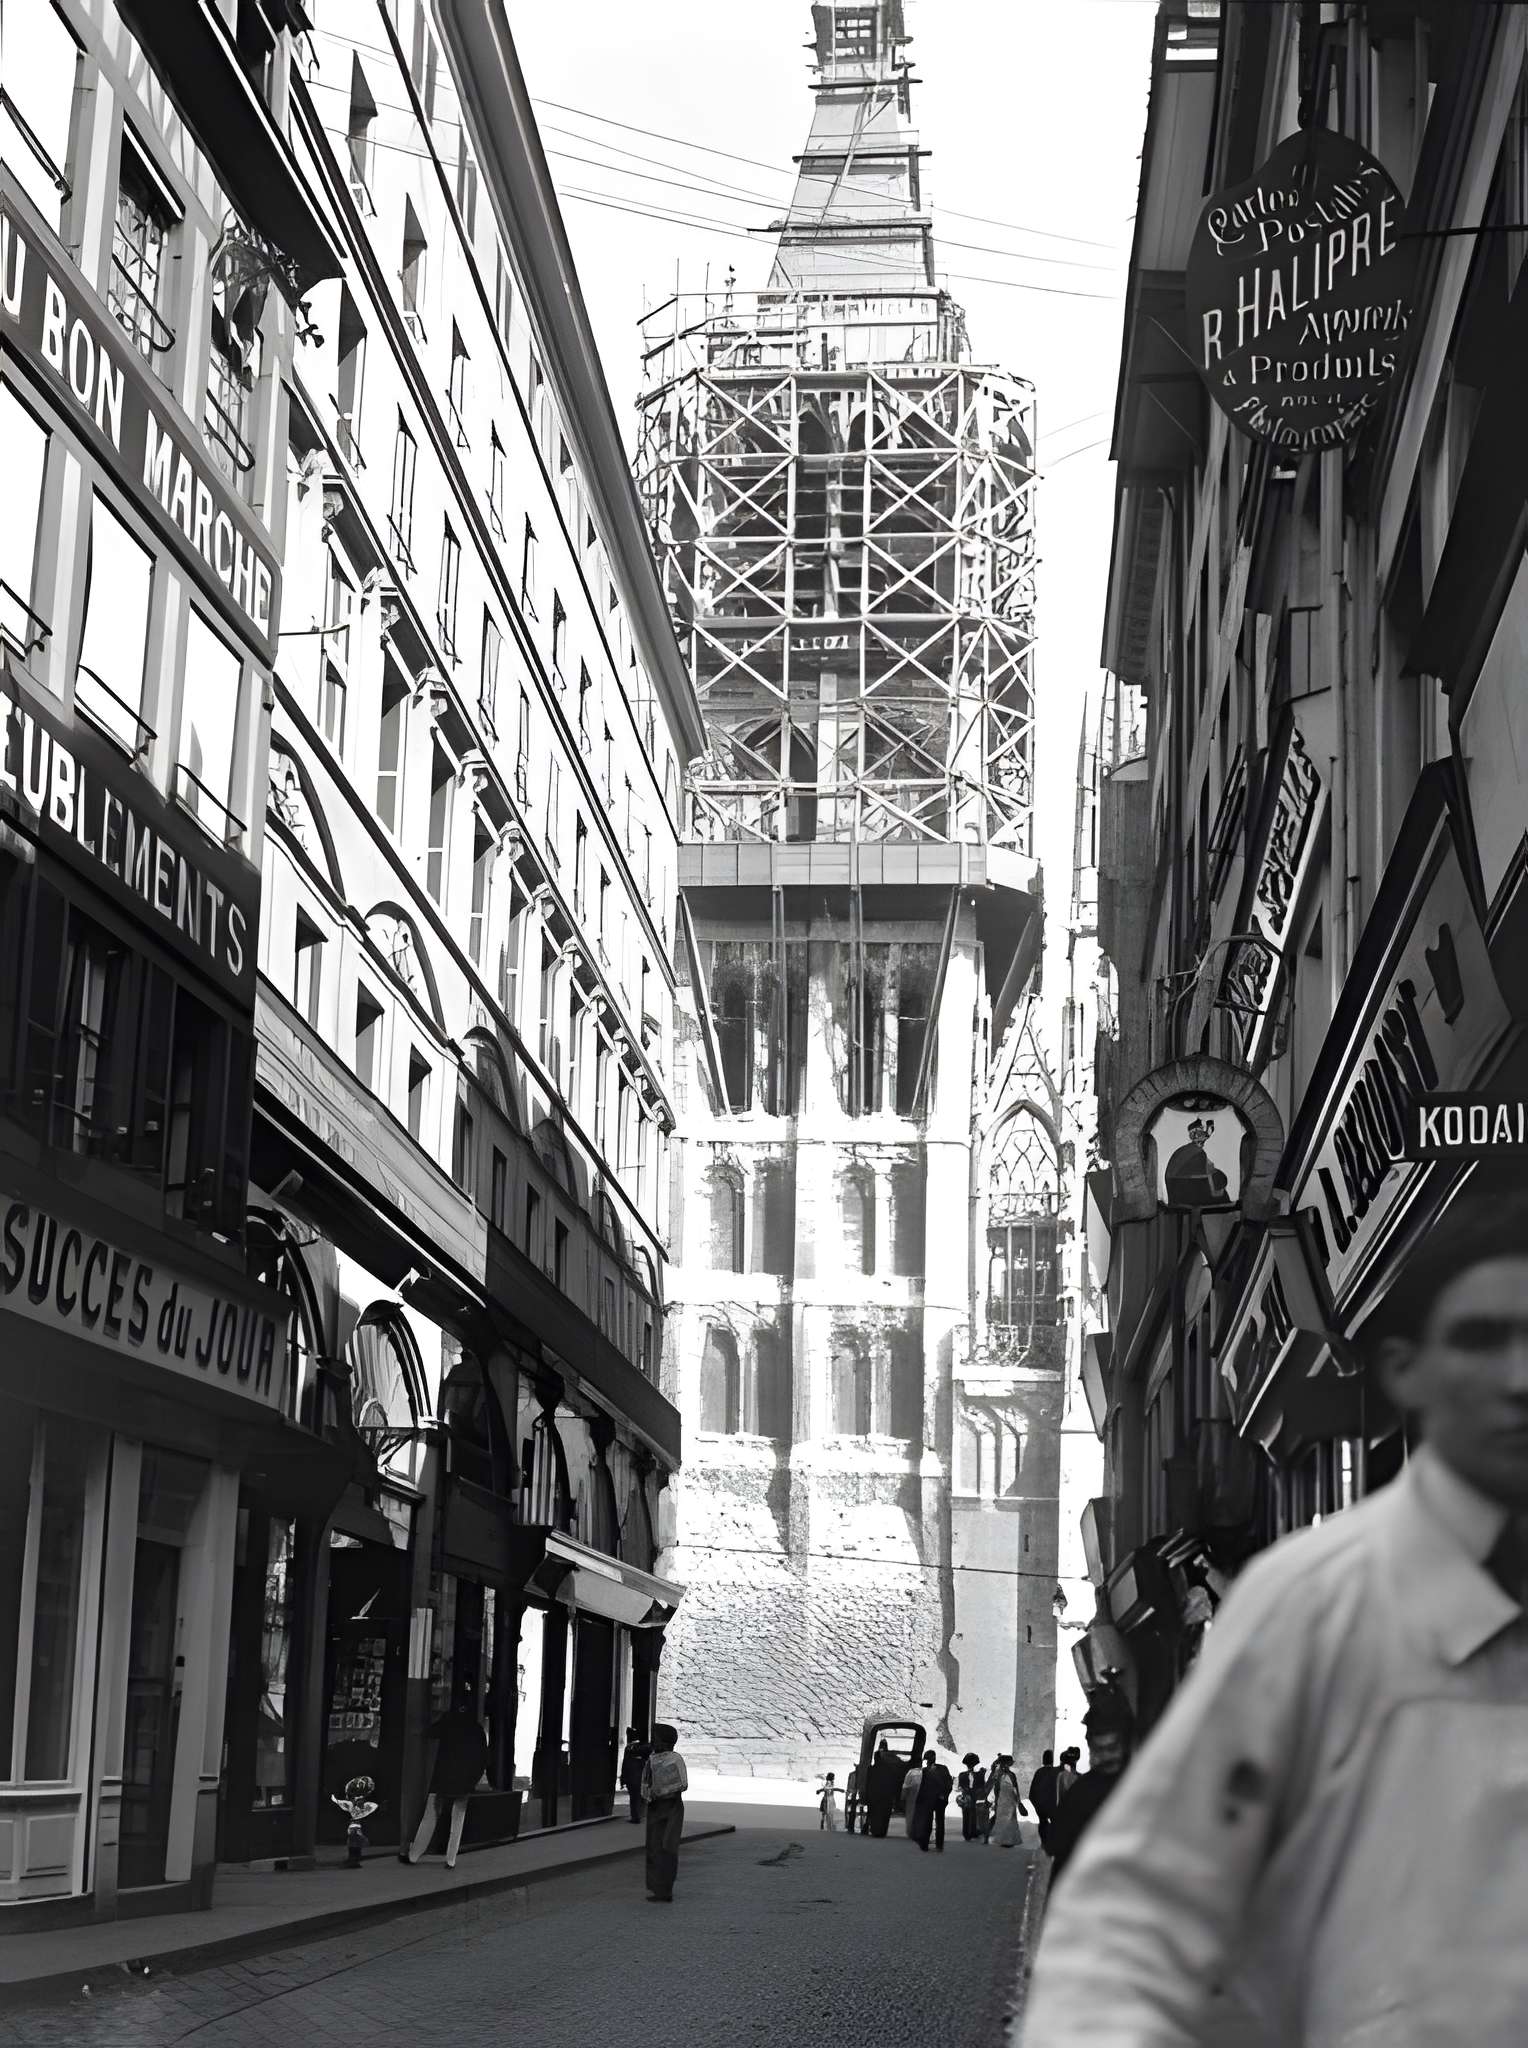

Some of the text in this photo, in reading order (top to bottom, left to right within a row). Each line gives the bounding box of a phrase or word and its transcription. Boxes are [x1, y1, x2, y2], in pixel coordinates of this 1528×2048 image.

[1203, 309, 1223, 370] R
[41, 273, 125, 454] BON
[143, 409, 271, 641] MARCHE
[0, 1203, 276, 1397] SUCCES du JOUR
